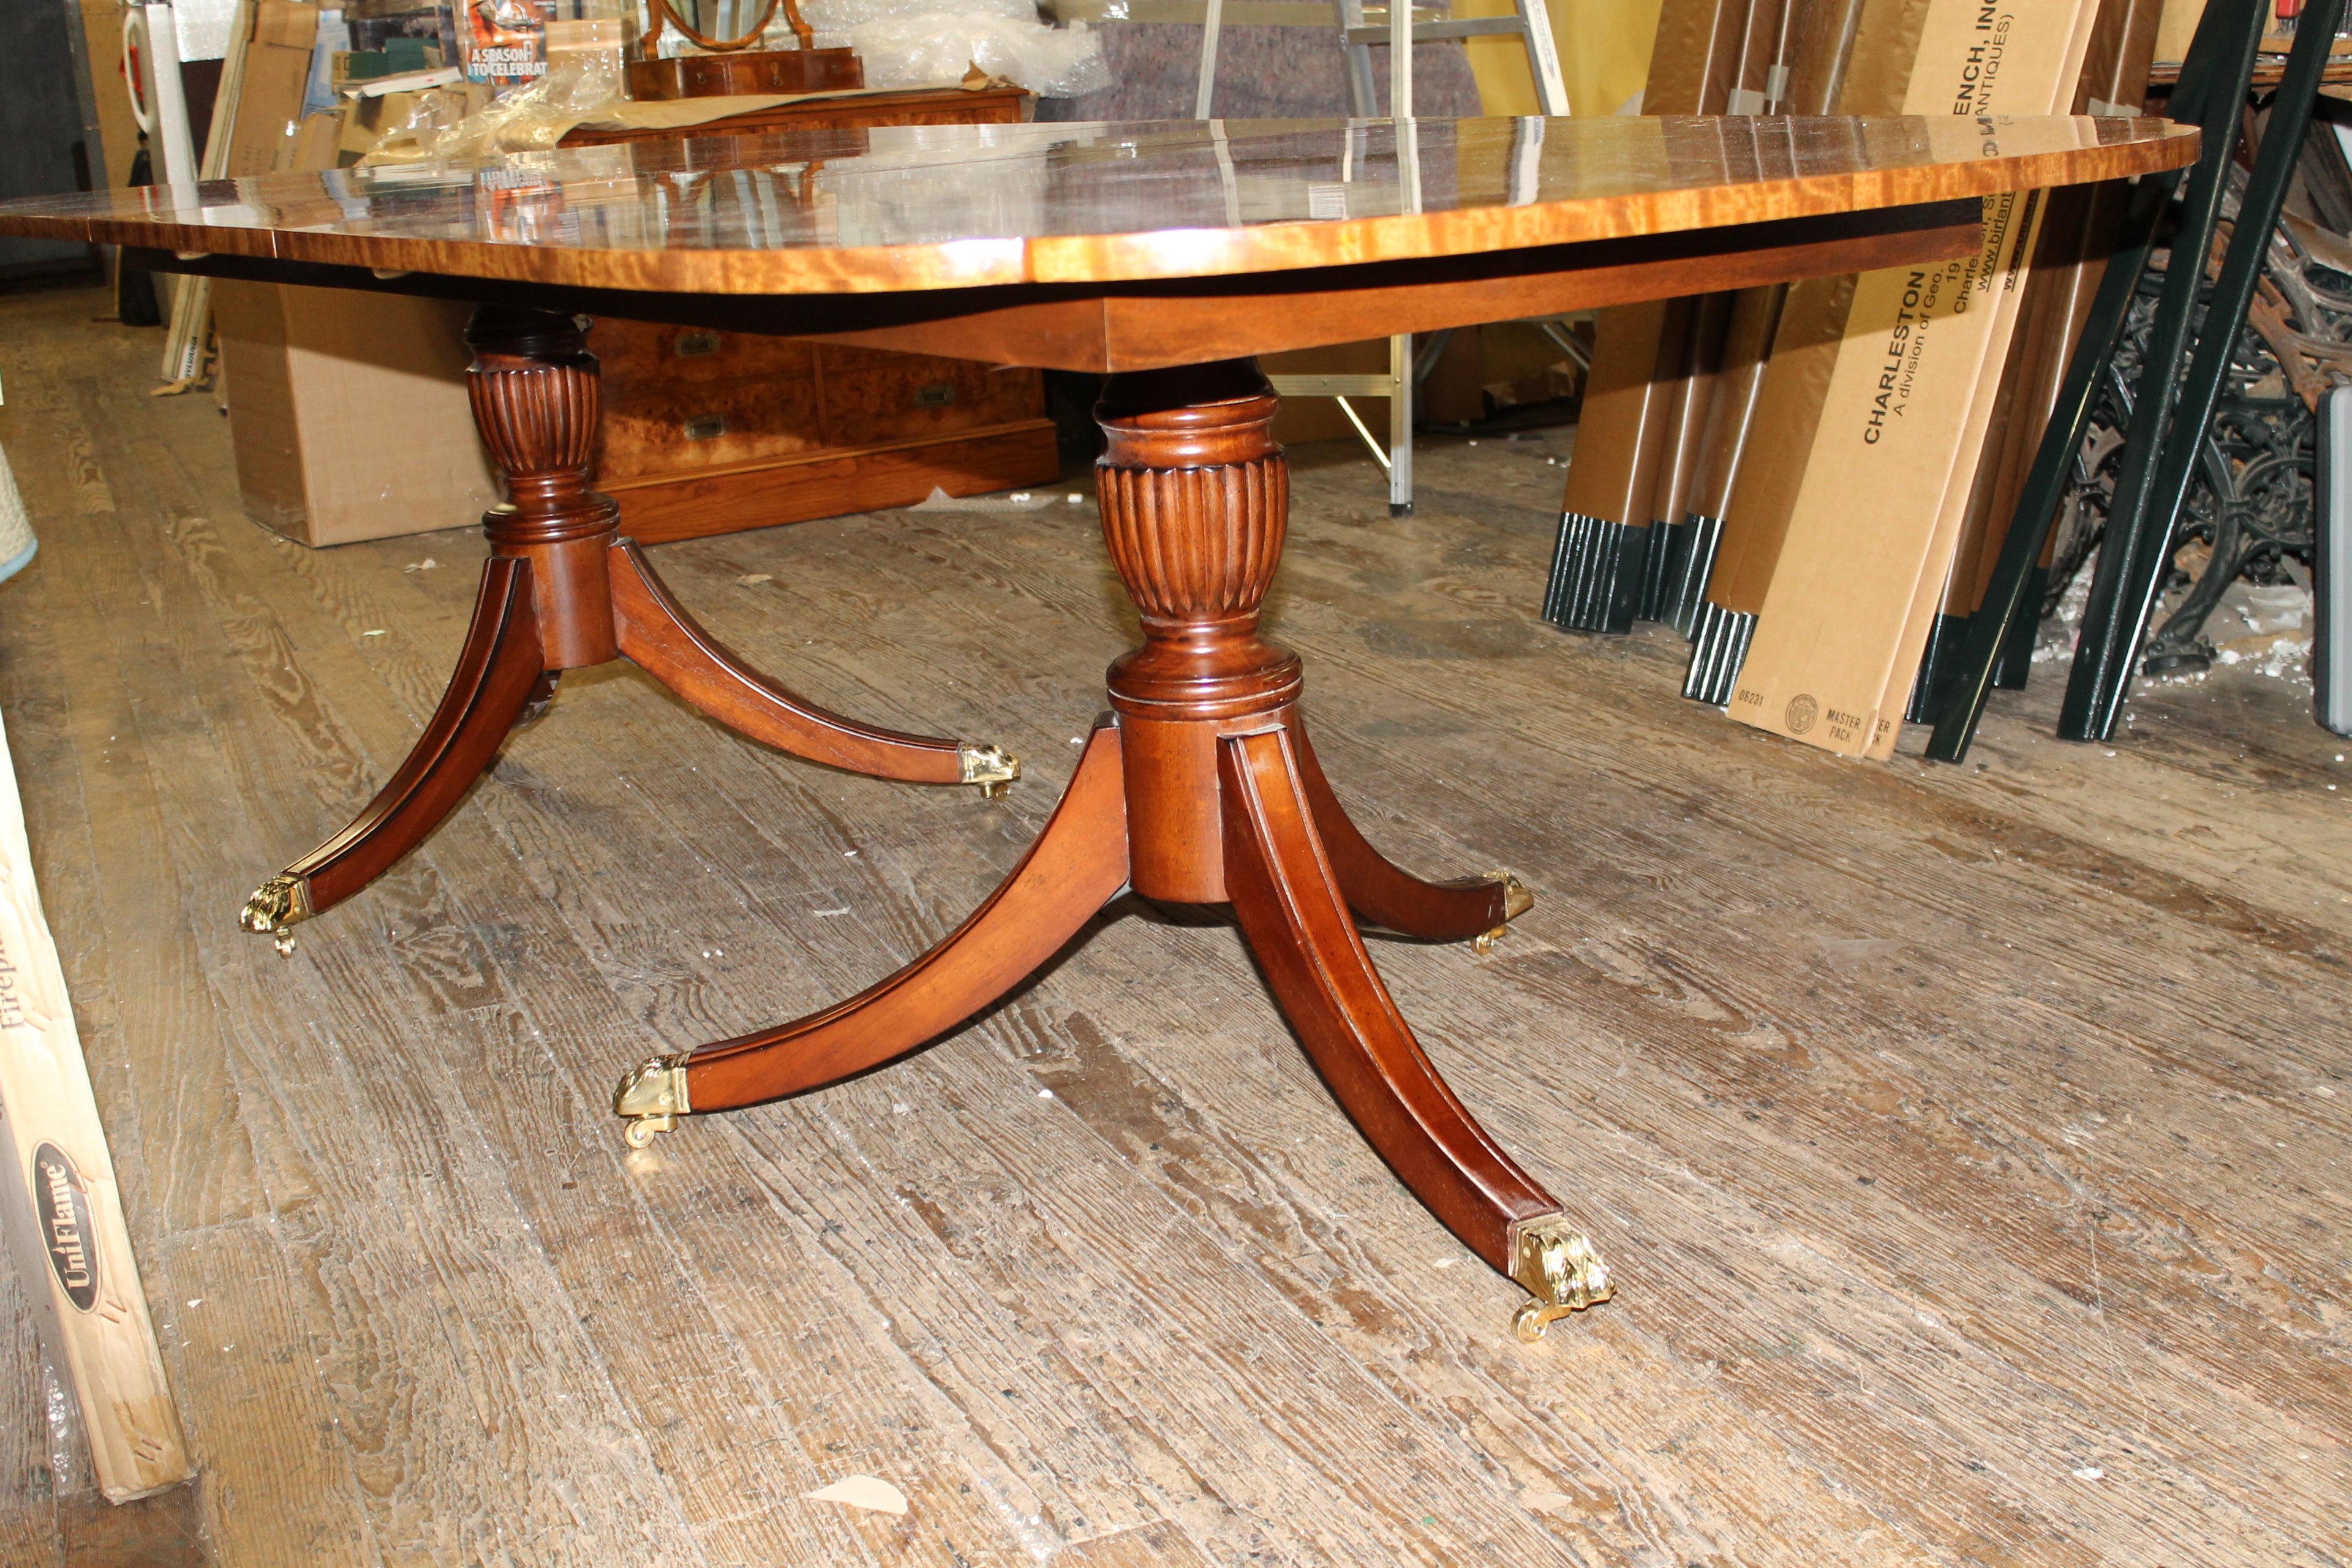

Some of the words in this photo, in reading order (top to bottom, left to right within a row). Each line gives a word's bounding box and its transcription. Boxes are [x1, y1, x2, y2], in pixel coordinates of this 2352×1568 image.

[471, 49, 480, 62] A
[481, 48, 529, 62] SEASON
[1953, 40, 1990, 115] ENCH,
[1975, 0, 1999, 30] IN
[472, 62, 488, 77] TO
[489, 62, 548, 77] CELEBRAT
[1977, 191, 2015, 292] www.birlant
[1923, 269, 1944, 308] Geo.
[1920, 312, 1931, 330] of
[1864, 271, 1926, 445] CHARLESTON
[1901, 336, 1925, 398] division
[1894, 403, 1906, 417] A
[1738, 689, 1765, 707] 06231
[1826, 709, 1861, 730] MASTER
[1830, 726, 1853, 743] PACK
